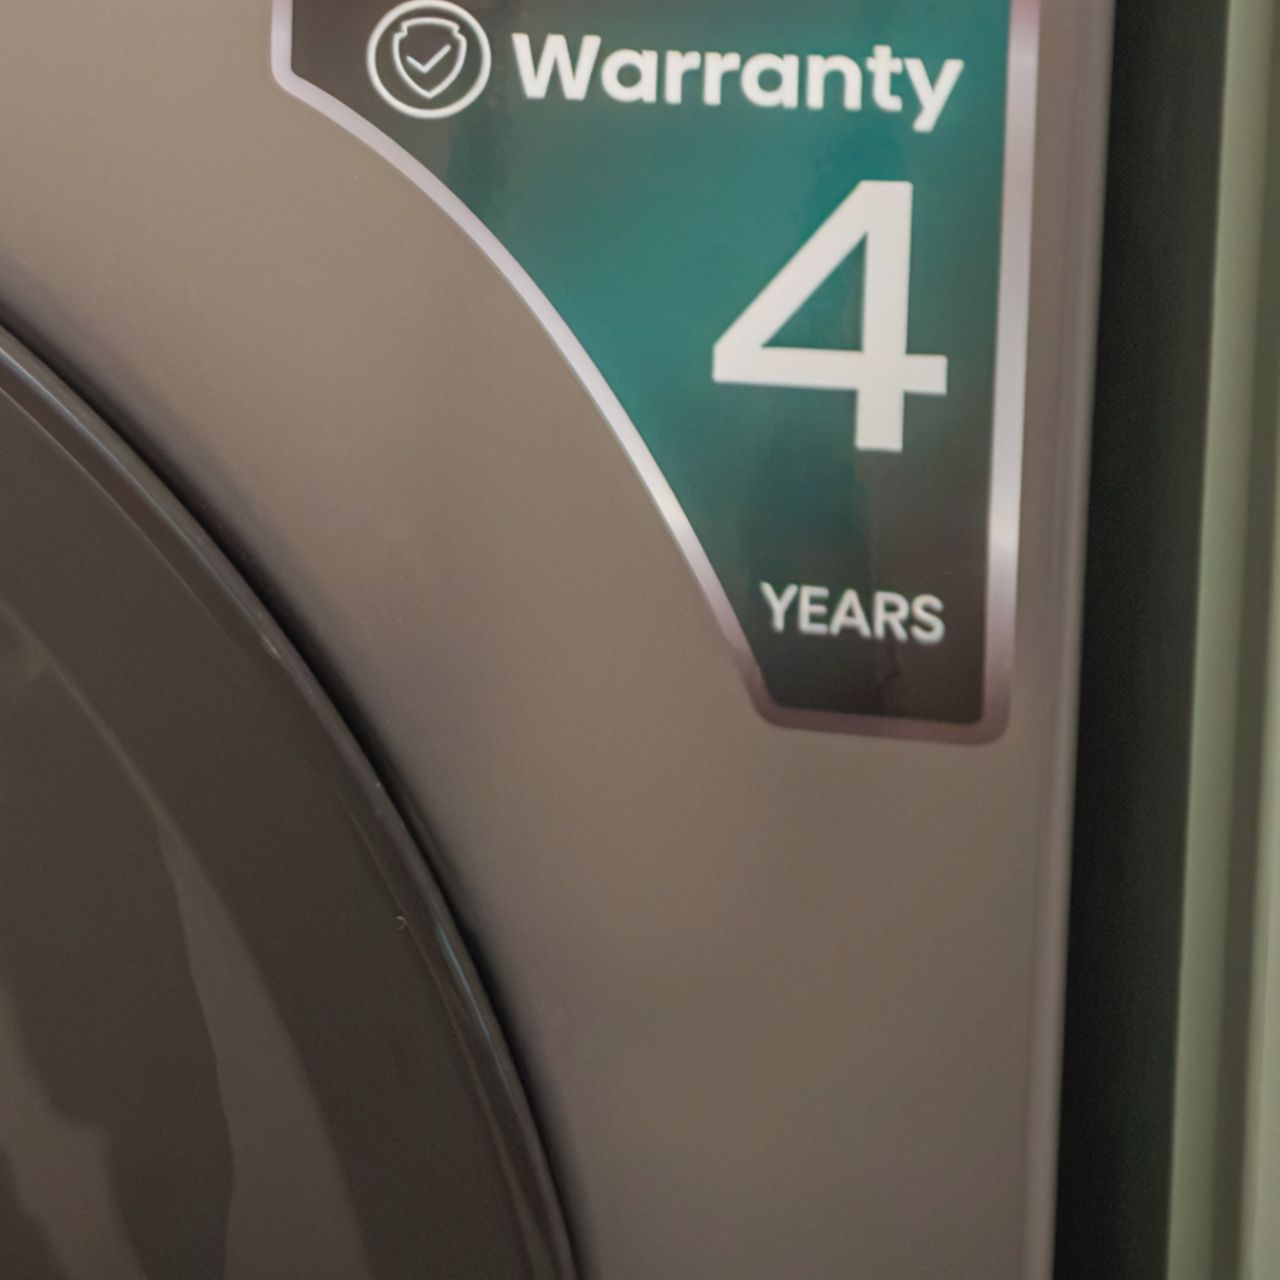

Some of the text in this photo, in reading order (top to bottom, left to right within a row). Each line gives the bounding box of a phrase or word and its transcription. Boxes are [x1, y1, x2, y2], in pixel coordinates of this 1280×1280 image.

[511, 32, 964, 133] Warranty
[711, 179, 948, 451] 4
[759, 582, 945, 644] YEARS
